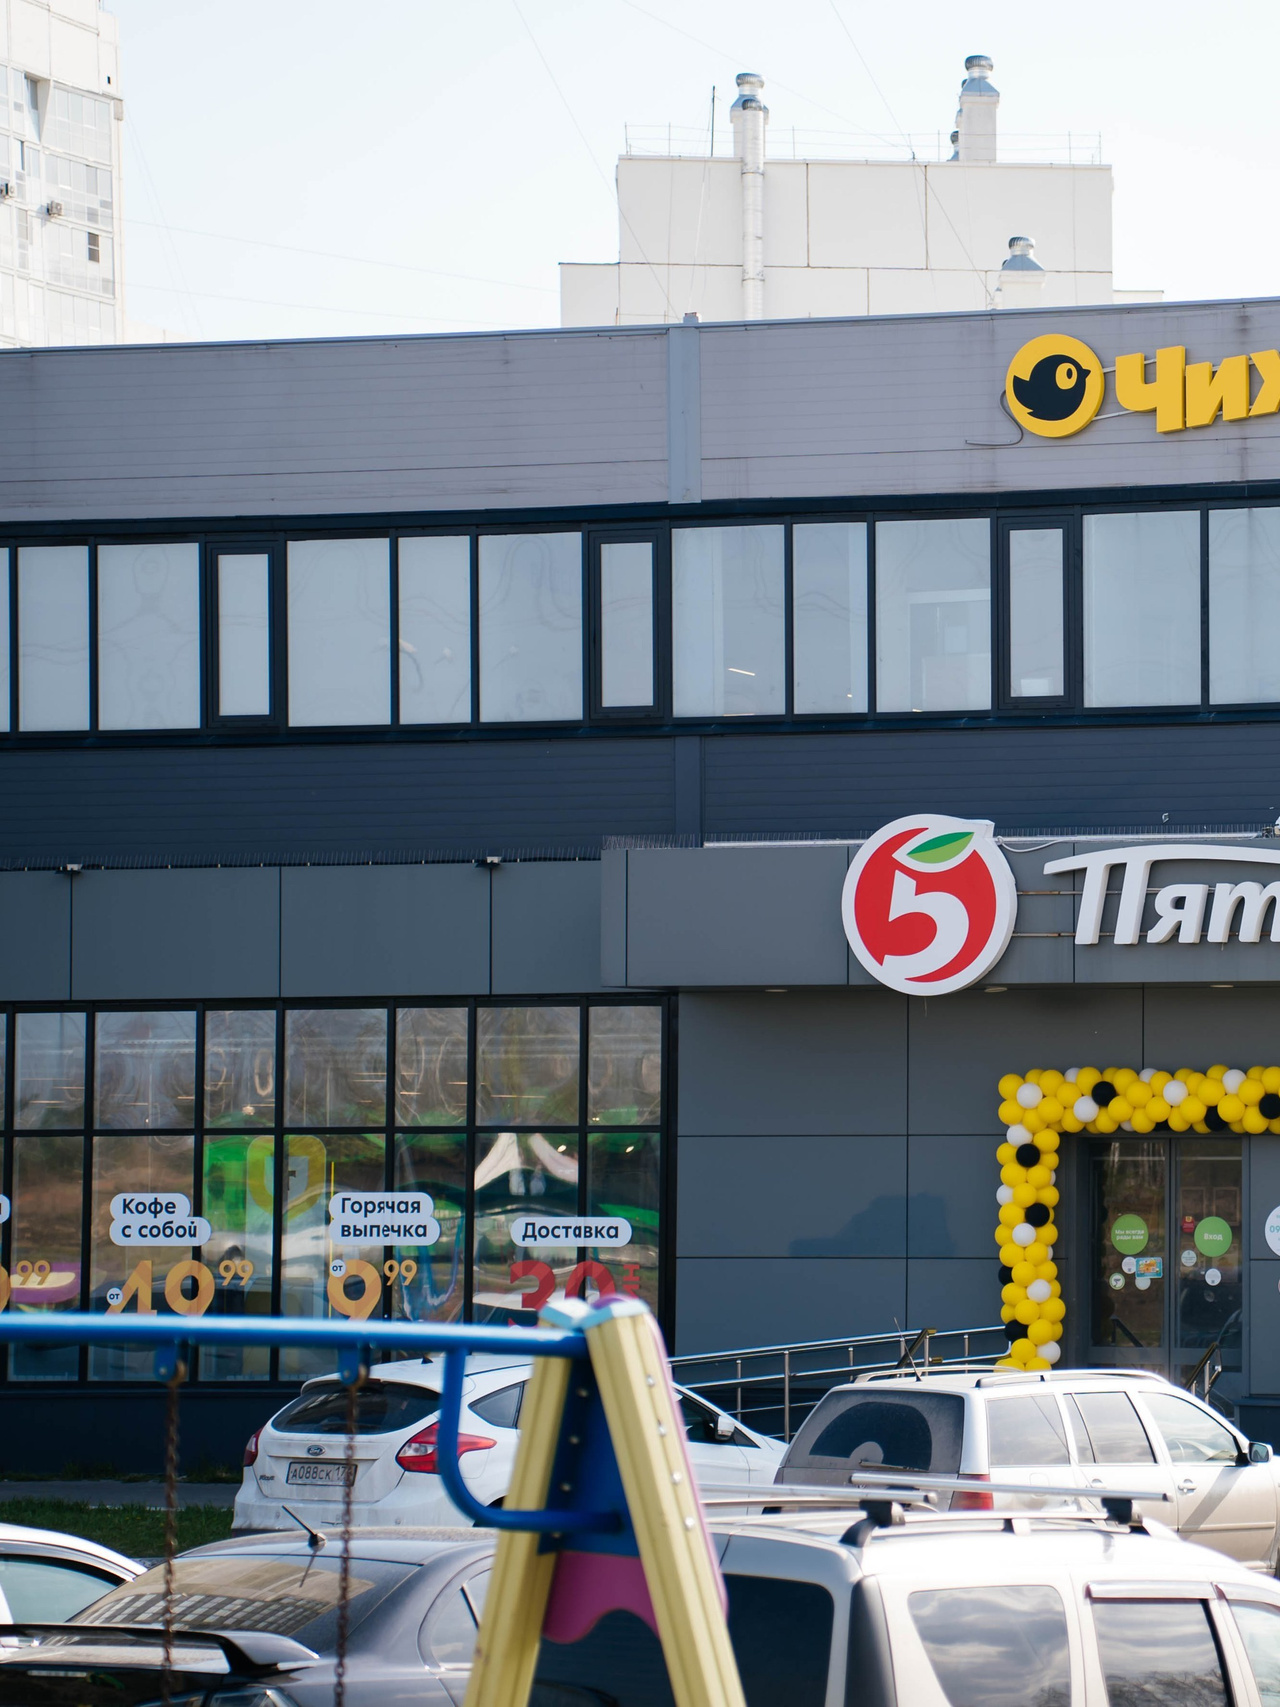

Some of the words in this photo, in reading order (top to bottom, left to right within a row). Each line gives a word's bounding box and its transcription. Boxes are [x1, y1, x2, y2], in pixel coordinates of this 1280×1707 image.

[122, 1198, 177, 1218] Кофе
[341, 1198, 422, 1217] Горячая
[121, 1224, 132, 1238] с
[138, 1220, 197, 1238] собой
[341, 1224, 428, 1238] выпечка
[522, 1222, 620, 1241] Доставка
[1204, 1233, 1223, 1241] Вход
[16, 1260, 51, 1286] 99
